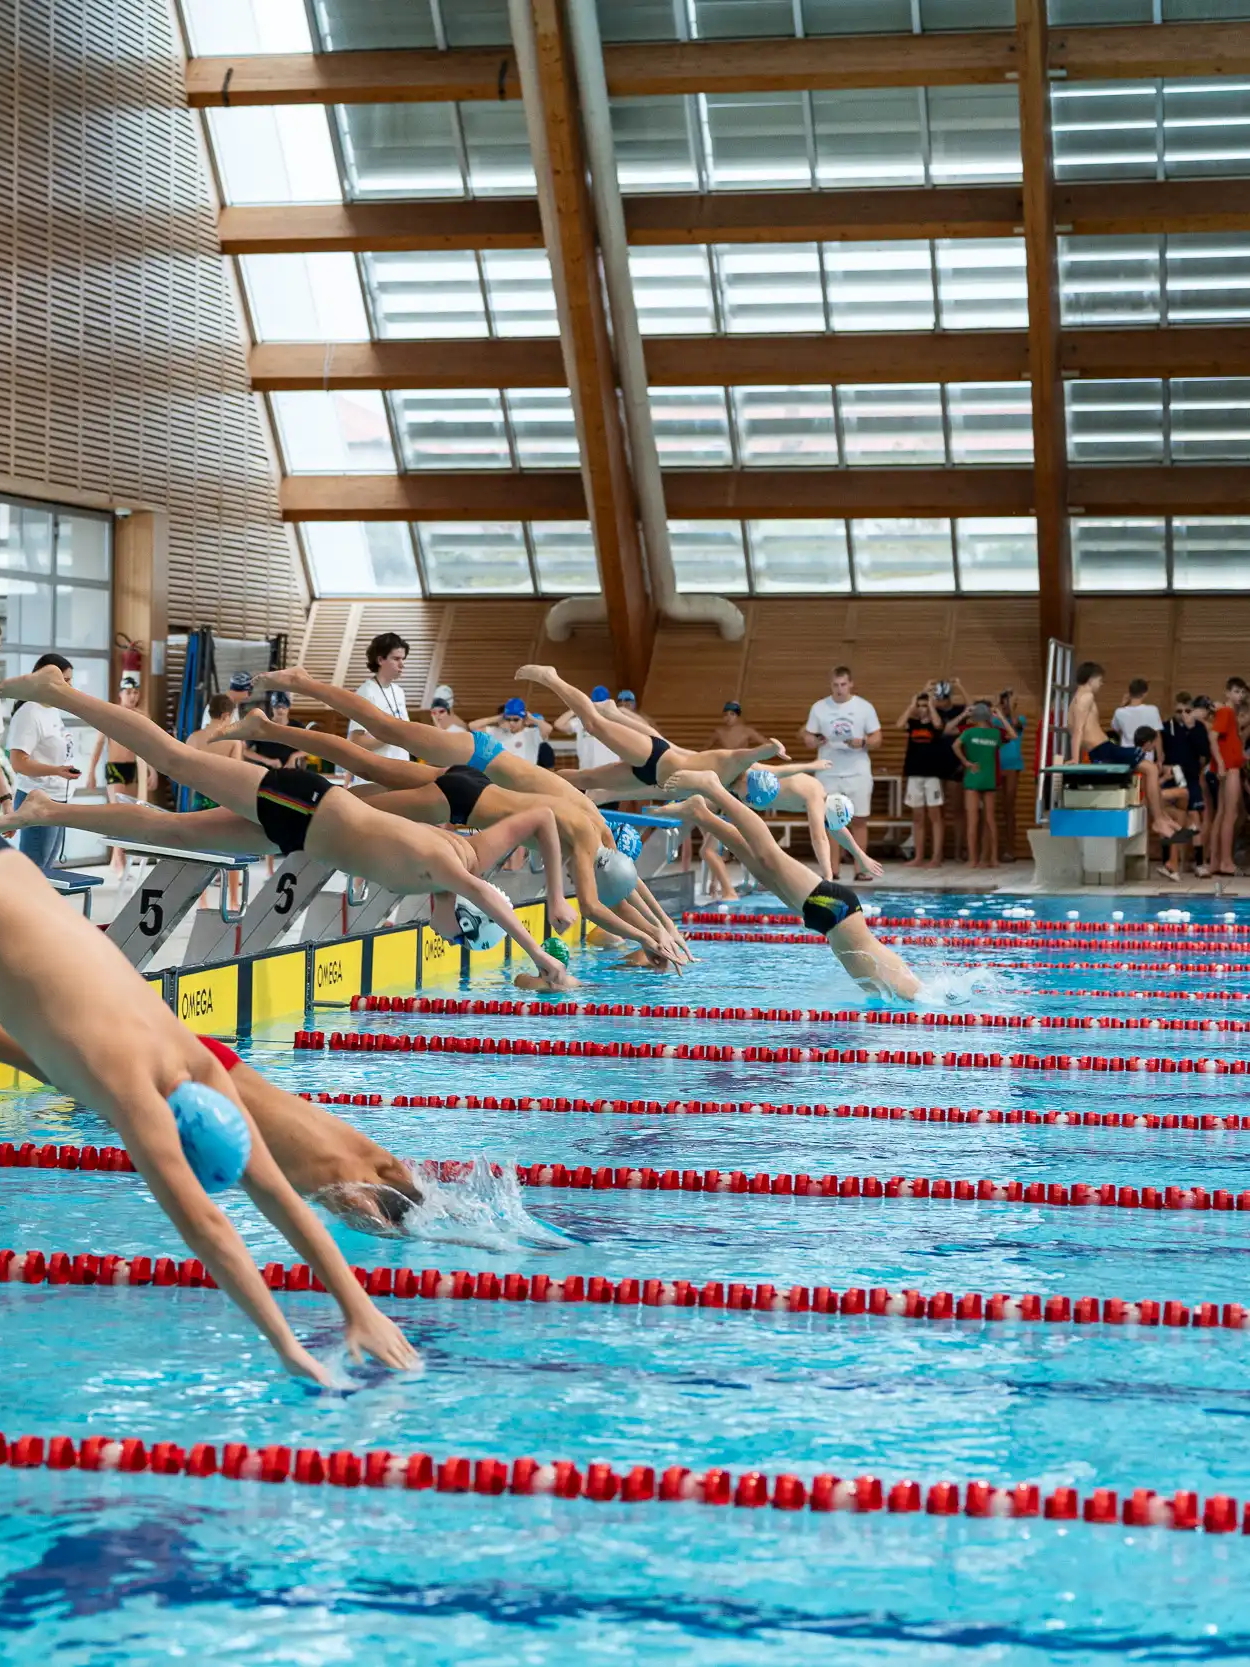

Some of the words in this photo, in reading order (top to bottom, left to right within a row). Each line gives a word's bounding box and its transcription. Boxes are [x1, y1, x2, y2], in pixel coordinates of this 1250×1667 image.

[139, 889, 164, 936] 5
[317, 960, 343, 988] OMEGA
[181, 987, 213, 1020] OMEGA
